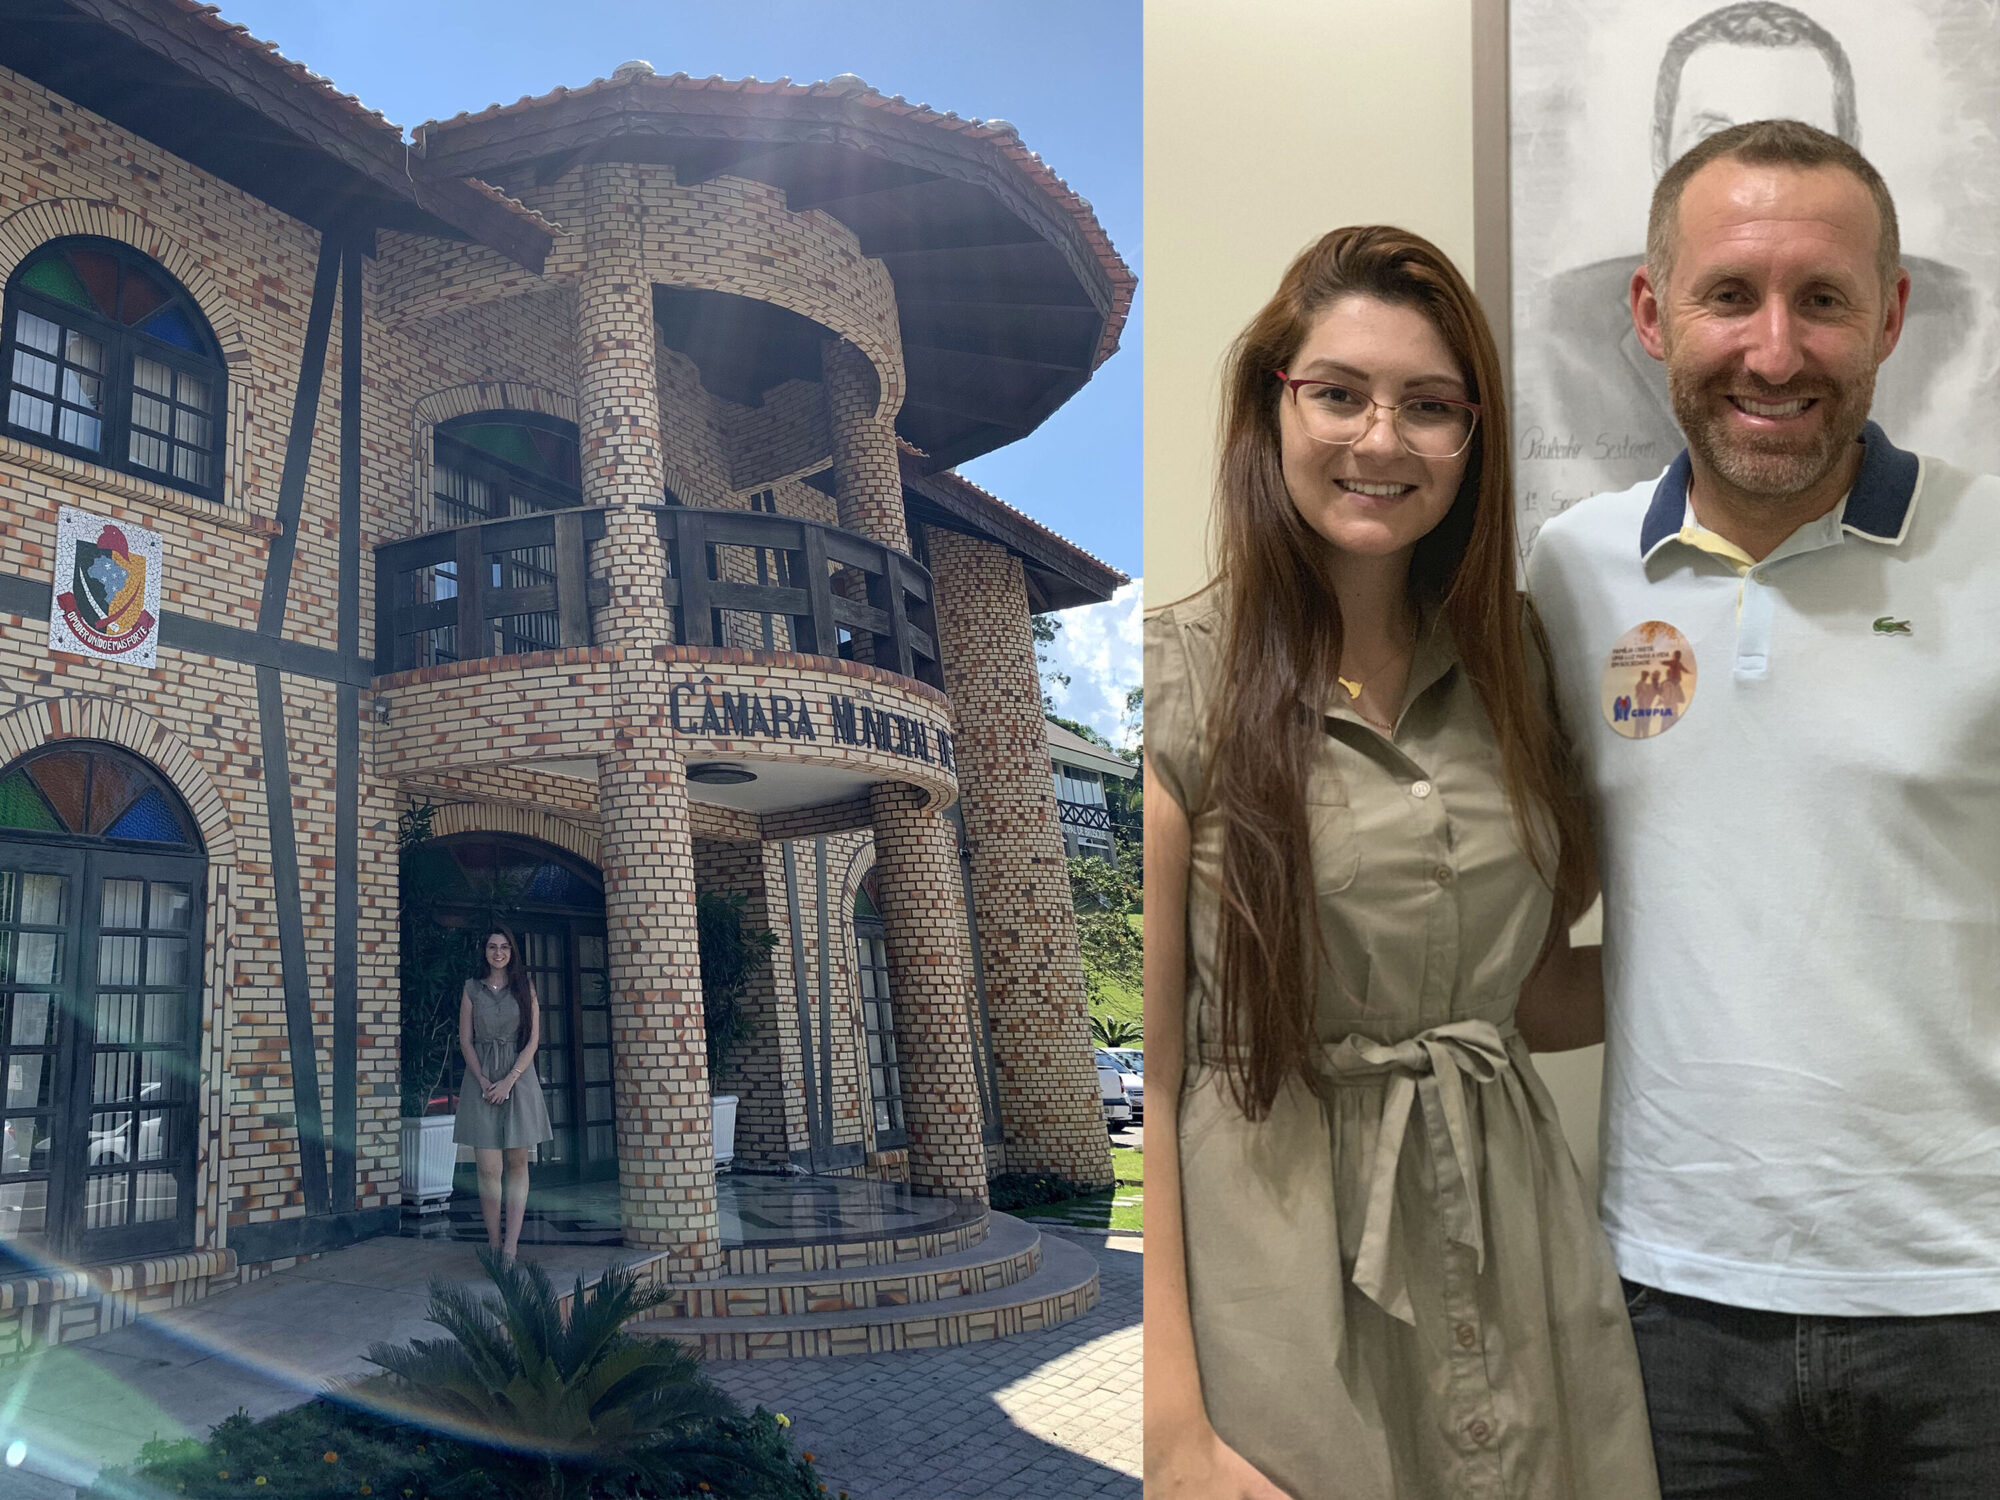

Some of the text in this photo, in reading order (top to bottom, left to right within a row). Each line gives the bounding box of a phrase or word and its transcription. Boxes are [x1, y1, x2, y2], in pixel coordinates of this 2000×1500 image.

[69, 615, 89, 640] PODER
[126, 626, 147, 647] FORTE
[669, 675, 816, 741] CÂMARA
[830, 694, 935, 763] MUNICIPAL
